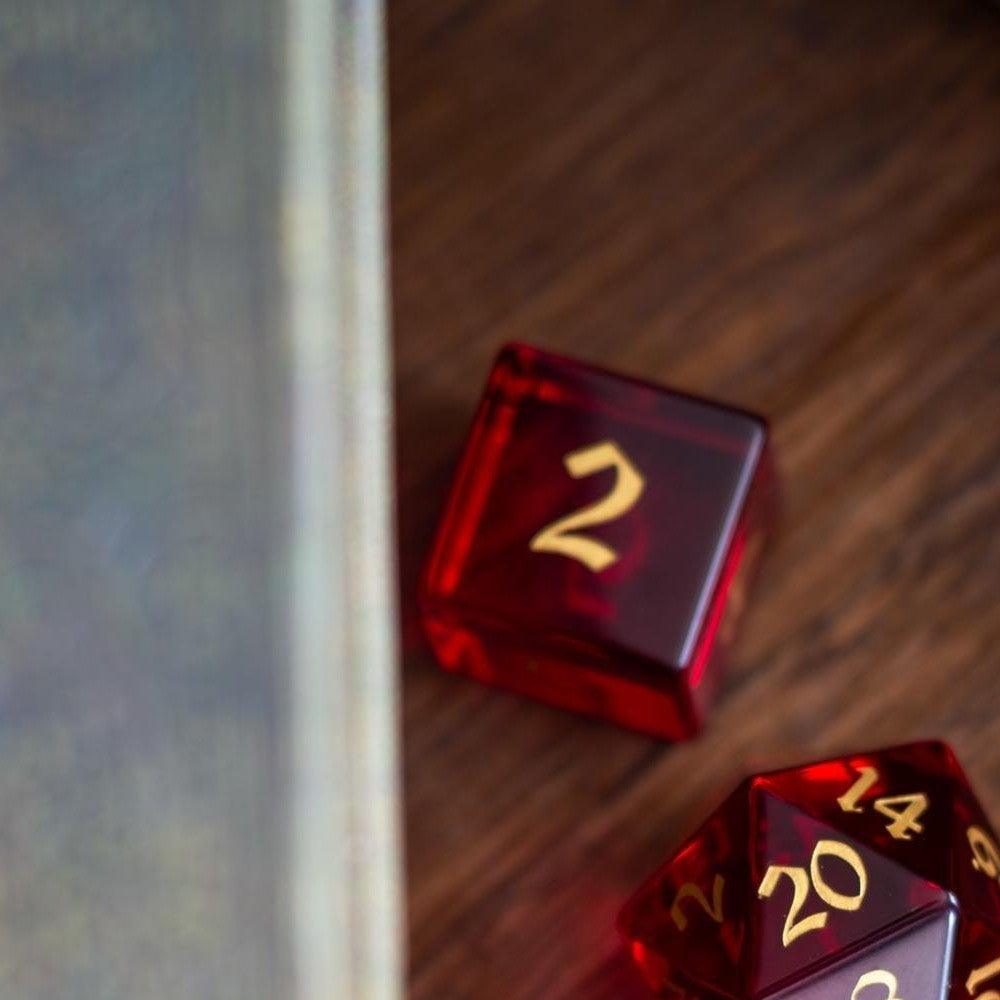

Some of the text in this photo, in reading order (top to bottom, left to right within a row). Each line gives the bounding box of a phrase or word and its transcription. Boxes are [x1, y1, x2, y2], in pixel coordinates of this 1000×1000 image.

[529, 441, 646, 573] 2
[837, 766, 928, 840] 14
[758, 840, 868, 947] 20
